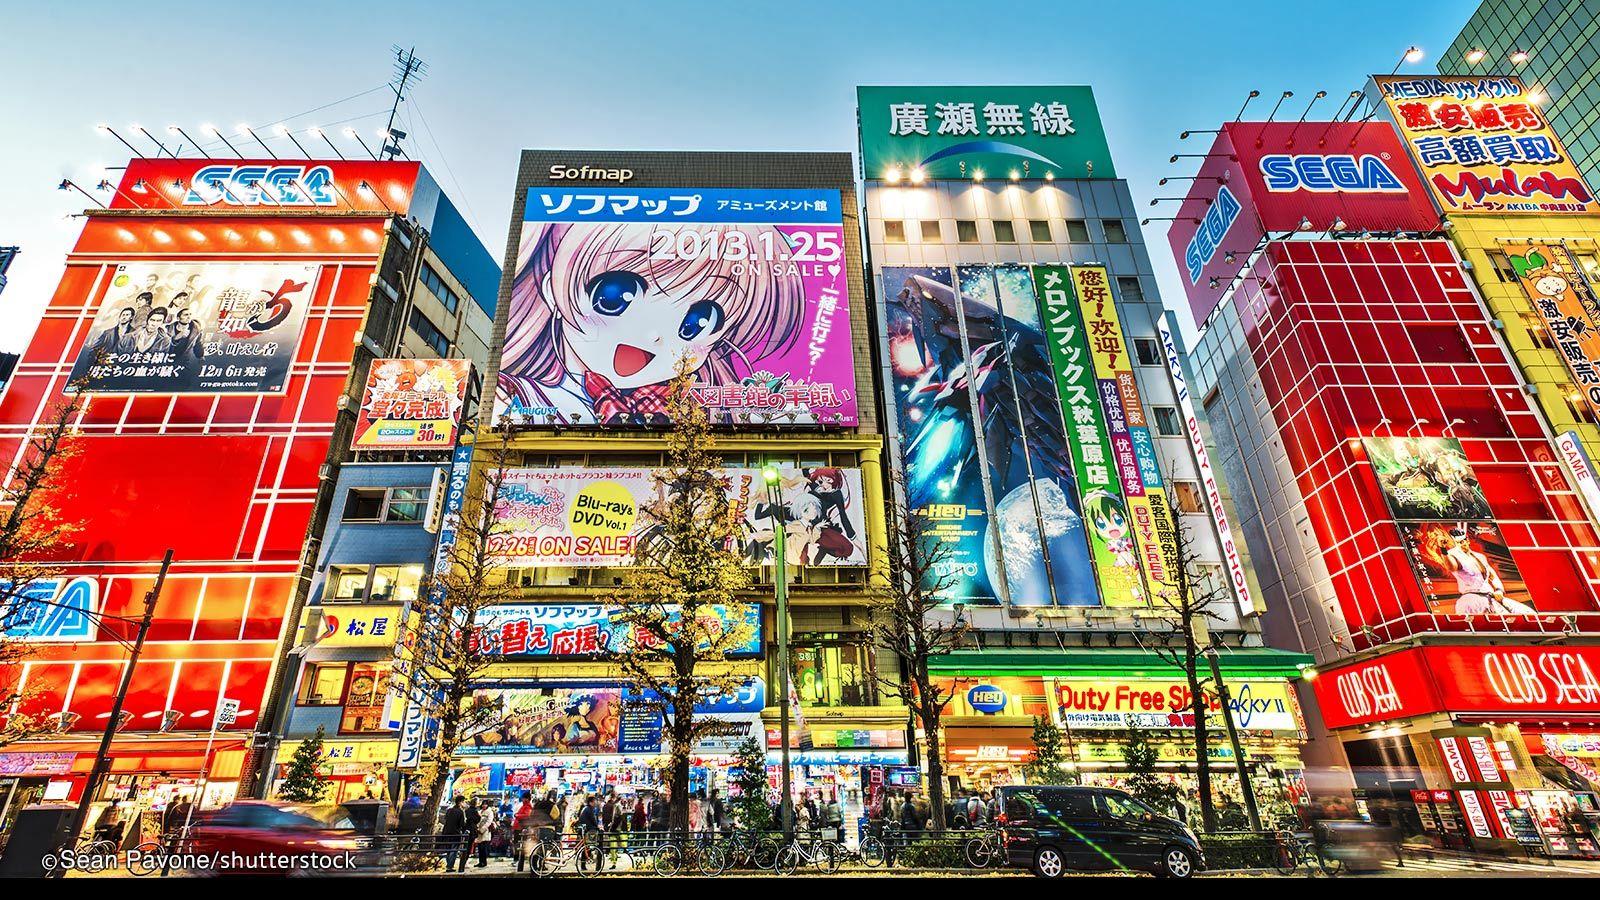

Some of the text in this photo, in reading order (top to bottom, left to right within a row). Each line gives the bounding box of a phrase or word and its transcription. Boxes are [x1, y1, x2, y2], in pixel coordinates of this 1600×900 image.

[889, 101, 1076, 136] 廣瀬無線
[1413, 134, 1559, 165] 高額買取
[183, 165, 337, 206] SEGA
[549, 165, 633, 182] Sofmap
[1258, 154, 1409, 193] SEGA
[540, 194, 828, 216] ソフマップ アミューズメント館
[1462, 202, 1505, 211] ムーラン
[651, 229, 841, 263] 2013.1.25
[1186, 185, 1242, 286] SEGA
[731, 263, 824, 277] ON SALE
[105, 352, 176, 364] その生き様に
[198, 365, 267, 378] 12月 6日 発売
[1538, 299, 1600, 414] 激安販売の
[1043, 271, 1110, 486] メロンブックス秋葉原店
[367, 400, 450, 419] 堂々完成!
[1101, 381, 1127, 434] 价格优惠
[1118, 373, 1144, 425] 货比三家
[1115, 438, 1142, 494] 优质服务
[1133, 430, 1159, 485] 安心购物
[1160, 329, 1184, 384] AKKY
[1188, 417, 1209, 469] DUTY
[1205, 478, 1228, 534] FREE
[1224, 541, 1249, 602] SHOP
[1561, 440, 1590, 481] GAME
[573, 511, 627, 530] DVD Vol.1
[577, 495, 633, 516] Blu-ray&
[539, 536, 571, 557] ON
[1133, 507, 1164, 581] DUTY FREE
[0, 578, 98, 641] GA
[346, 617, 389, 636] 松屋
[534, 606, 602, 619] ソフマップ
[1338, 671, 1372, 718] CLUB
[1362, 664, 1403, 715] SEGA
[1484, 652, 1600, 704] CLUB SEGA
[1060, 685, 1110, 711] Duty
[1116, 685, 1165, 711] Free
[401, 690, 426, 763] ソフマップ
[327, 746, 354, 758] 松屋
[1445, 738, 1466, 782] GAME
[1492, 791, 1516, 839] GME
